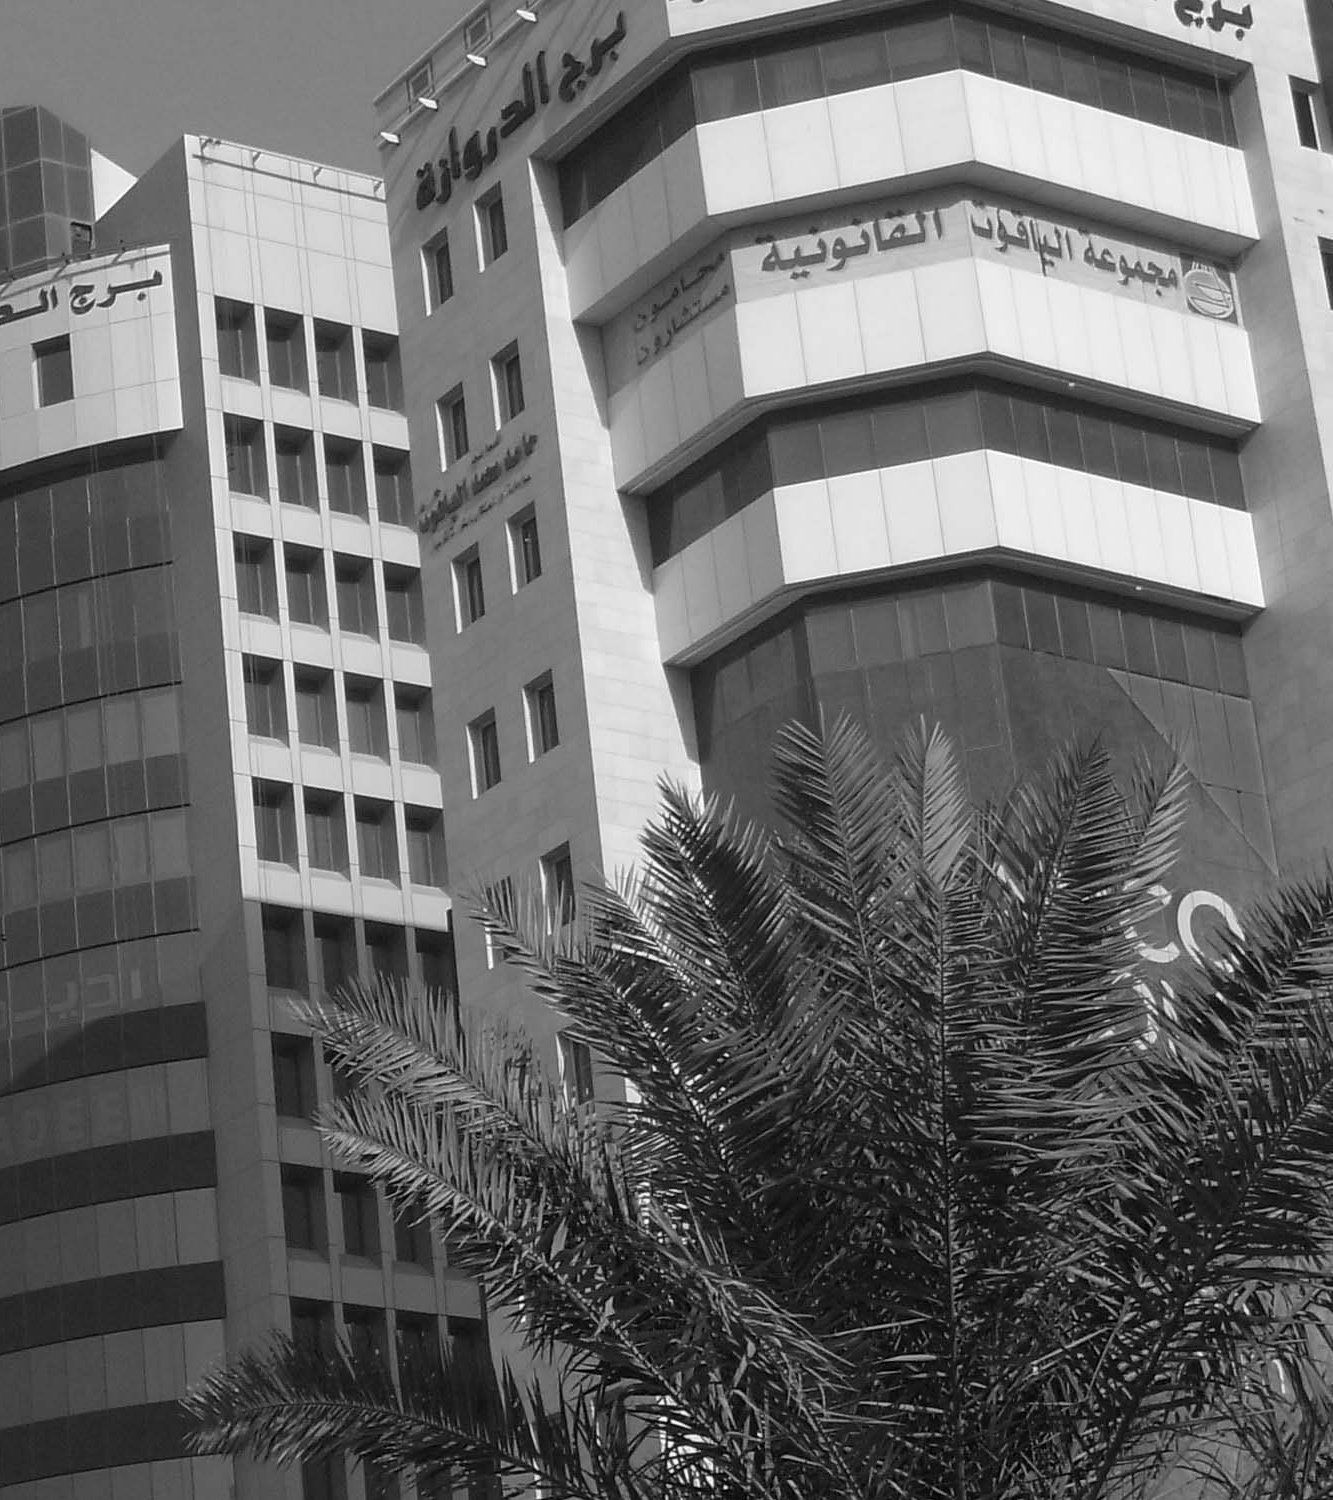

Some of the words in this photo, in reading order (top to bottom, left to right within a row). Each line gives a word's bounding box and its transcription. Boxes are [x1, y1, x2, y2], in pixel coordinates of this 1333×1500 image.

[558, 11, 626, 102] برج
[416, 50, 550, 210] الدروازة
[755, 208, 943, 280] القانونية
[970, 200, 1073, 270] الياقوت
[1078, 227, 1178, 296] مجموعة
[69, 267, 163, 315] برج
[634, 252, 726, 332] محامون
[637, 284, 731, 367] مستشارون
